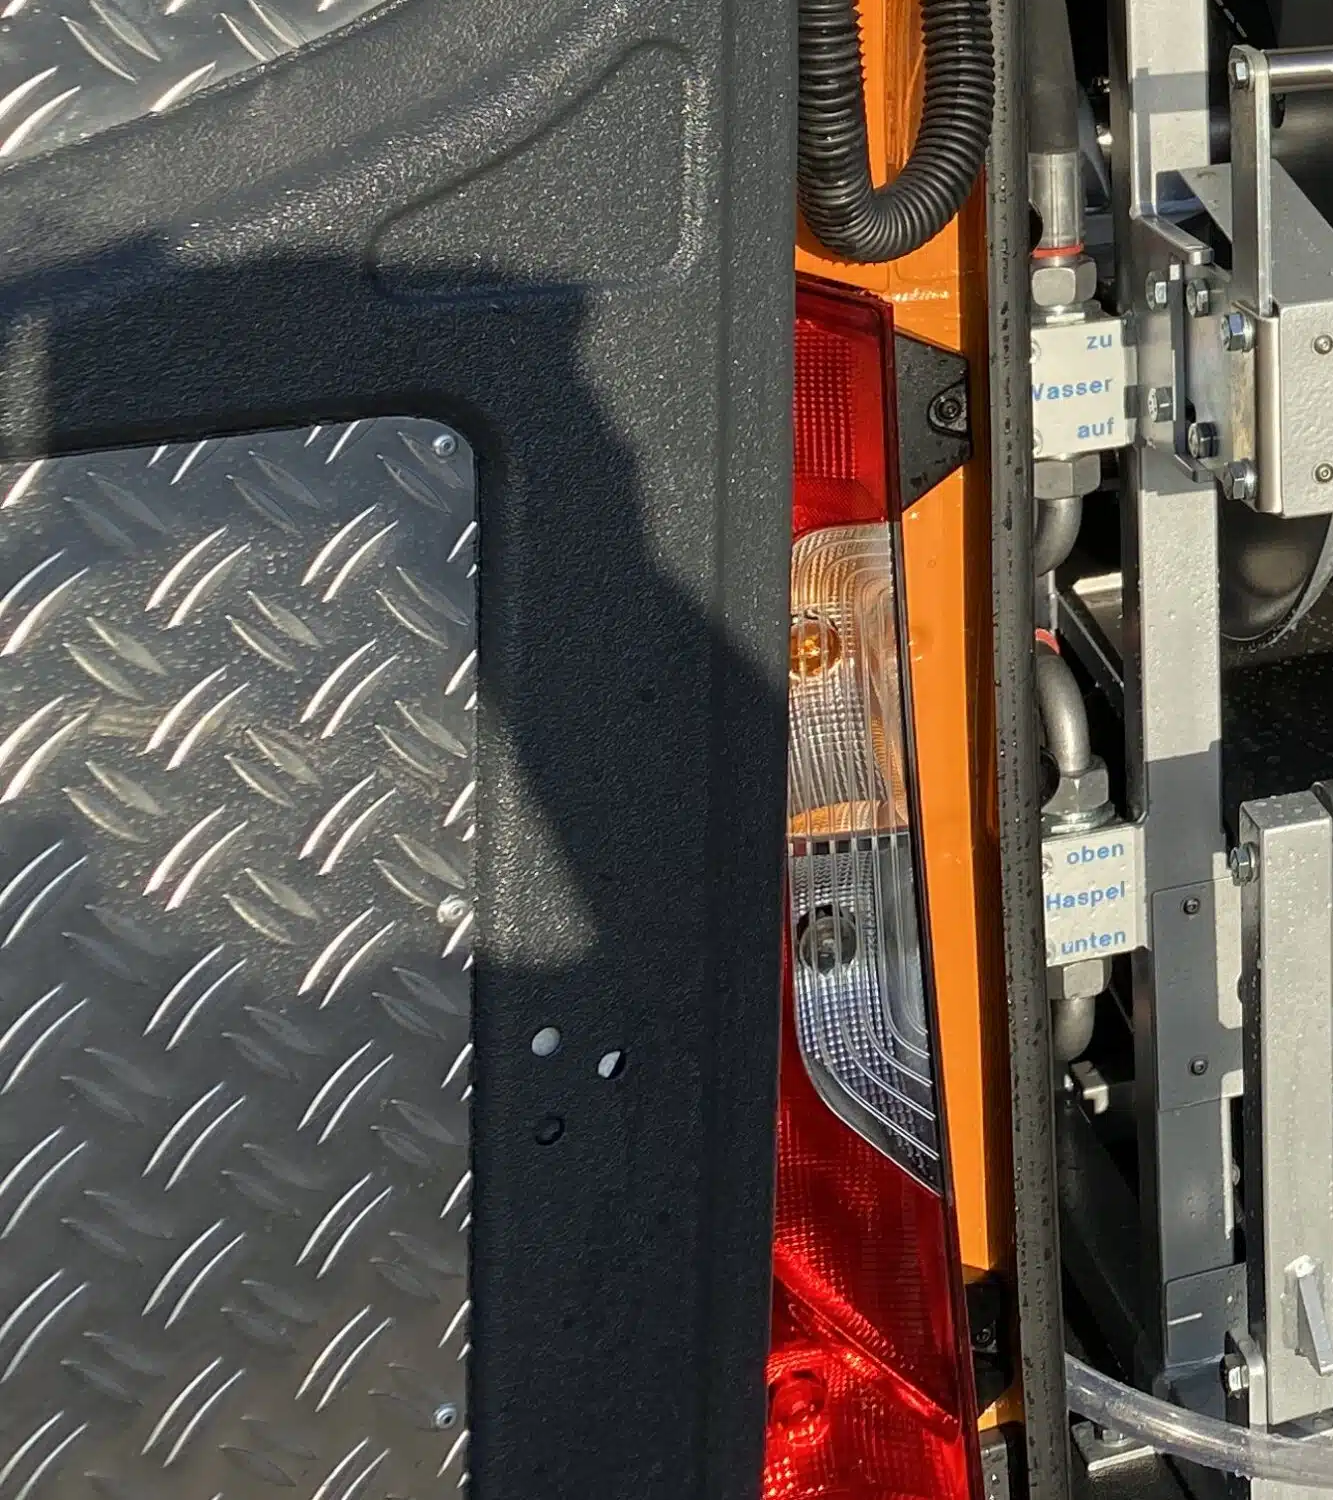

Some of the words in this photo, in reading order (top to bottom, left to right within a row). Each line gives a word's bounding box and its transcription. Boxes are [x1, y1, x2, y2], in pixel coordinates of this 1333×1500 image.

[1086, 334, 1112, 350] zu
[1077, 417, 1115, 439] auf
[1067, 843, 1124, 865] oben
[1046, 881, 1125, 911] Haspel
[1061, 930, 1126, 955] unten
